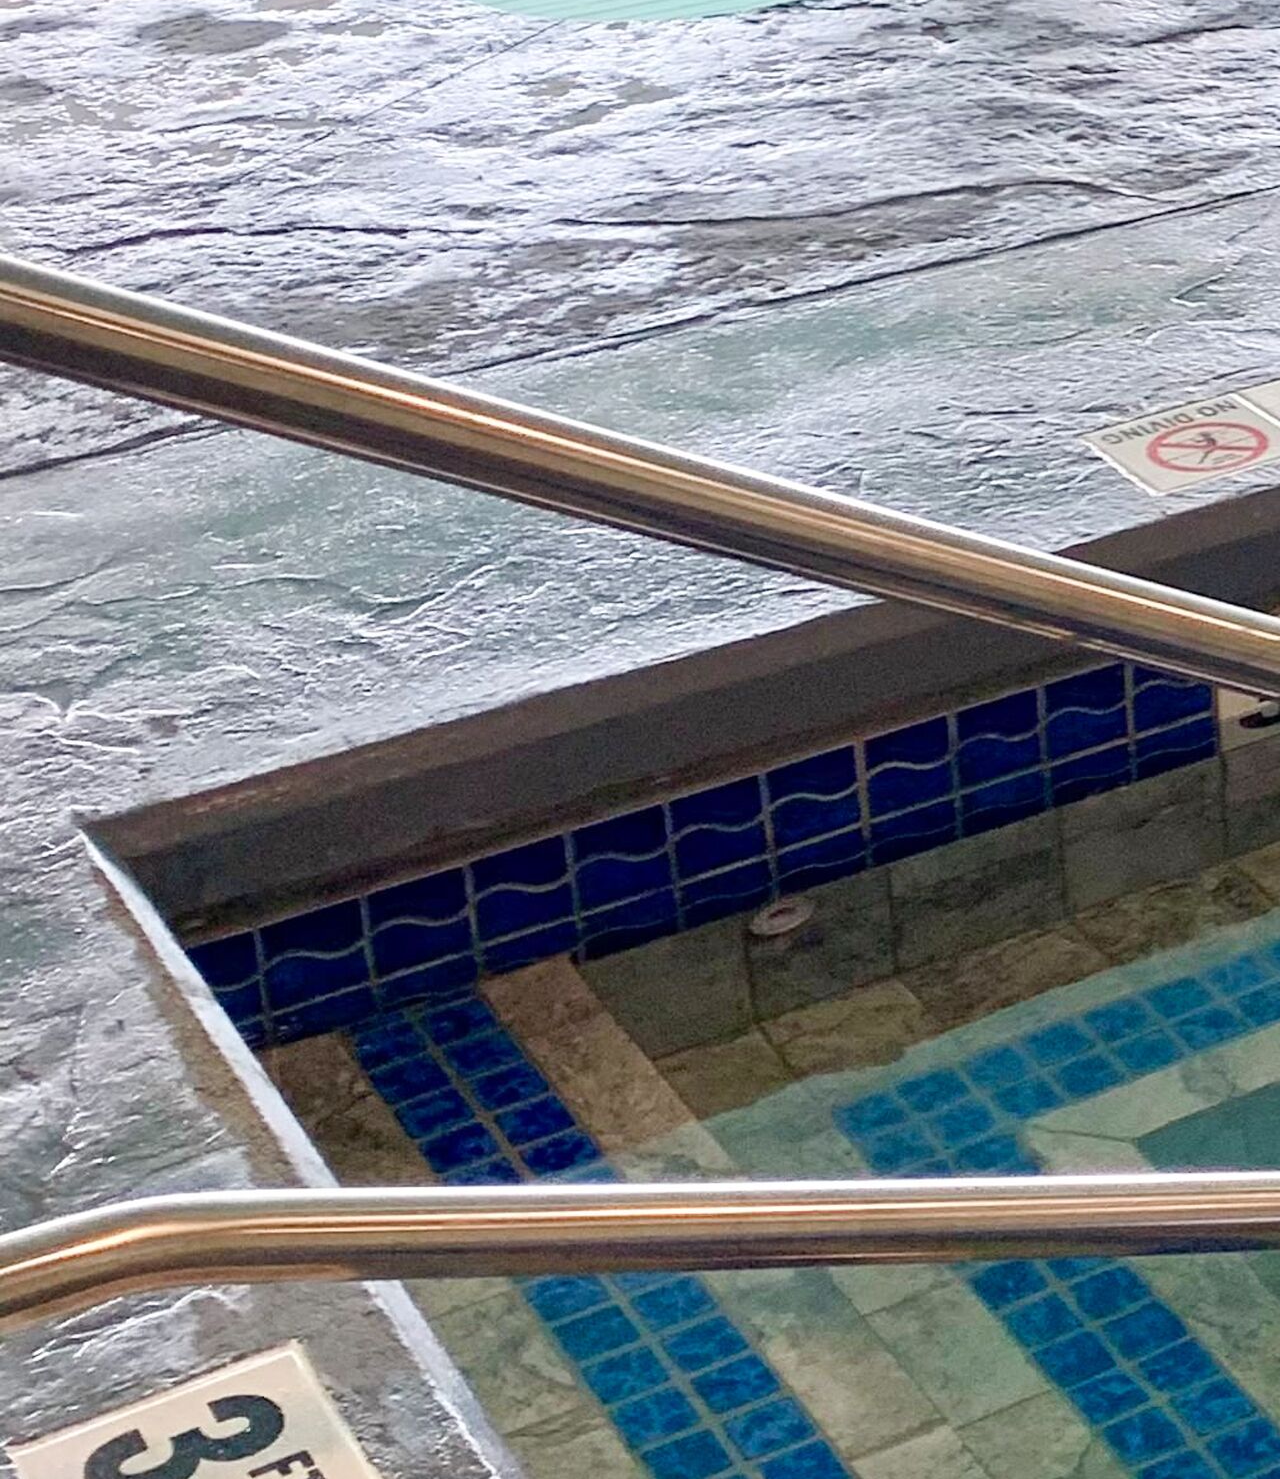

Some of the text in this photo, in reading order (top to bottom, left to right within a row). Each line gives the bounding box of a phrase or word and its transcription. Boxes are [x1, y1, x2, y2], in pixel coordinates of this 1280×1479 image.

[1101, 401, 1238, 444] NO DIVING
[84, 1394, 285, 1479] 3
